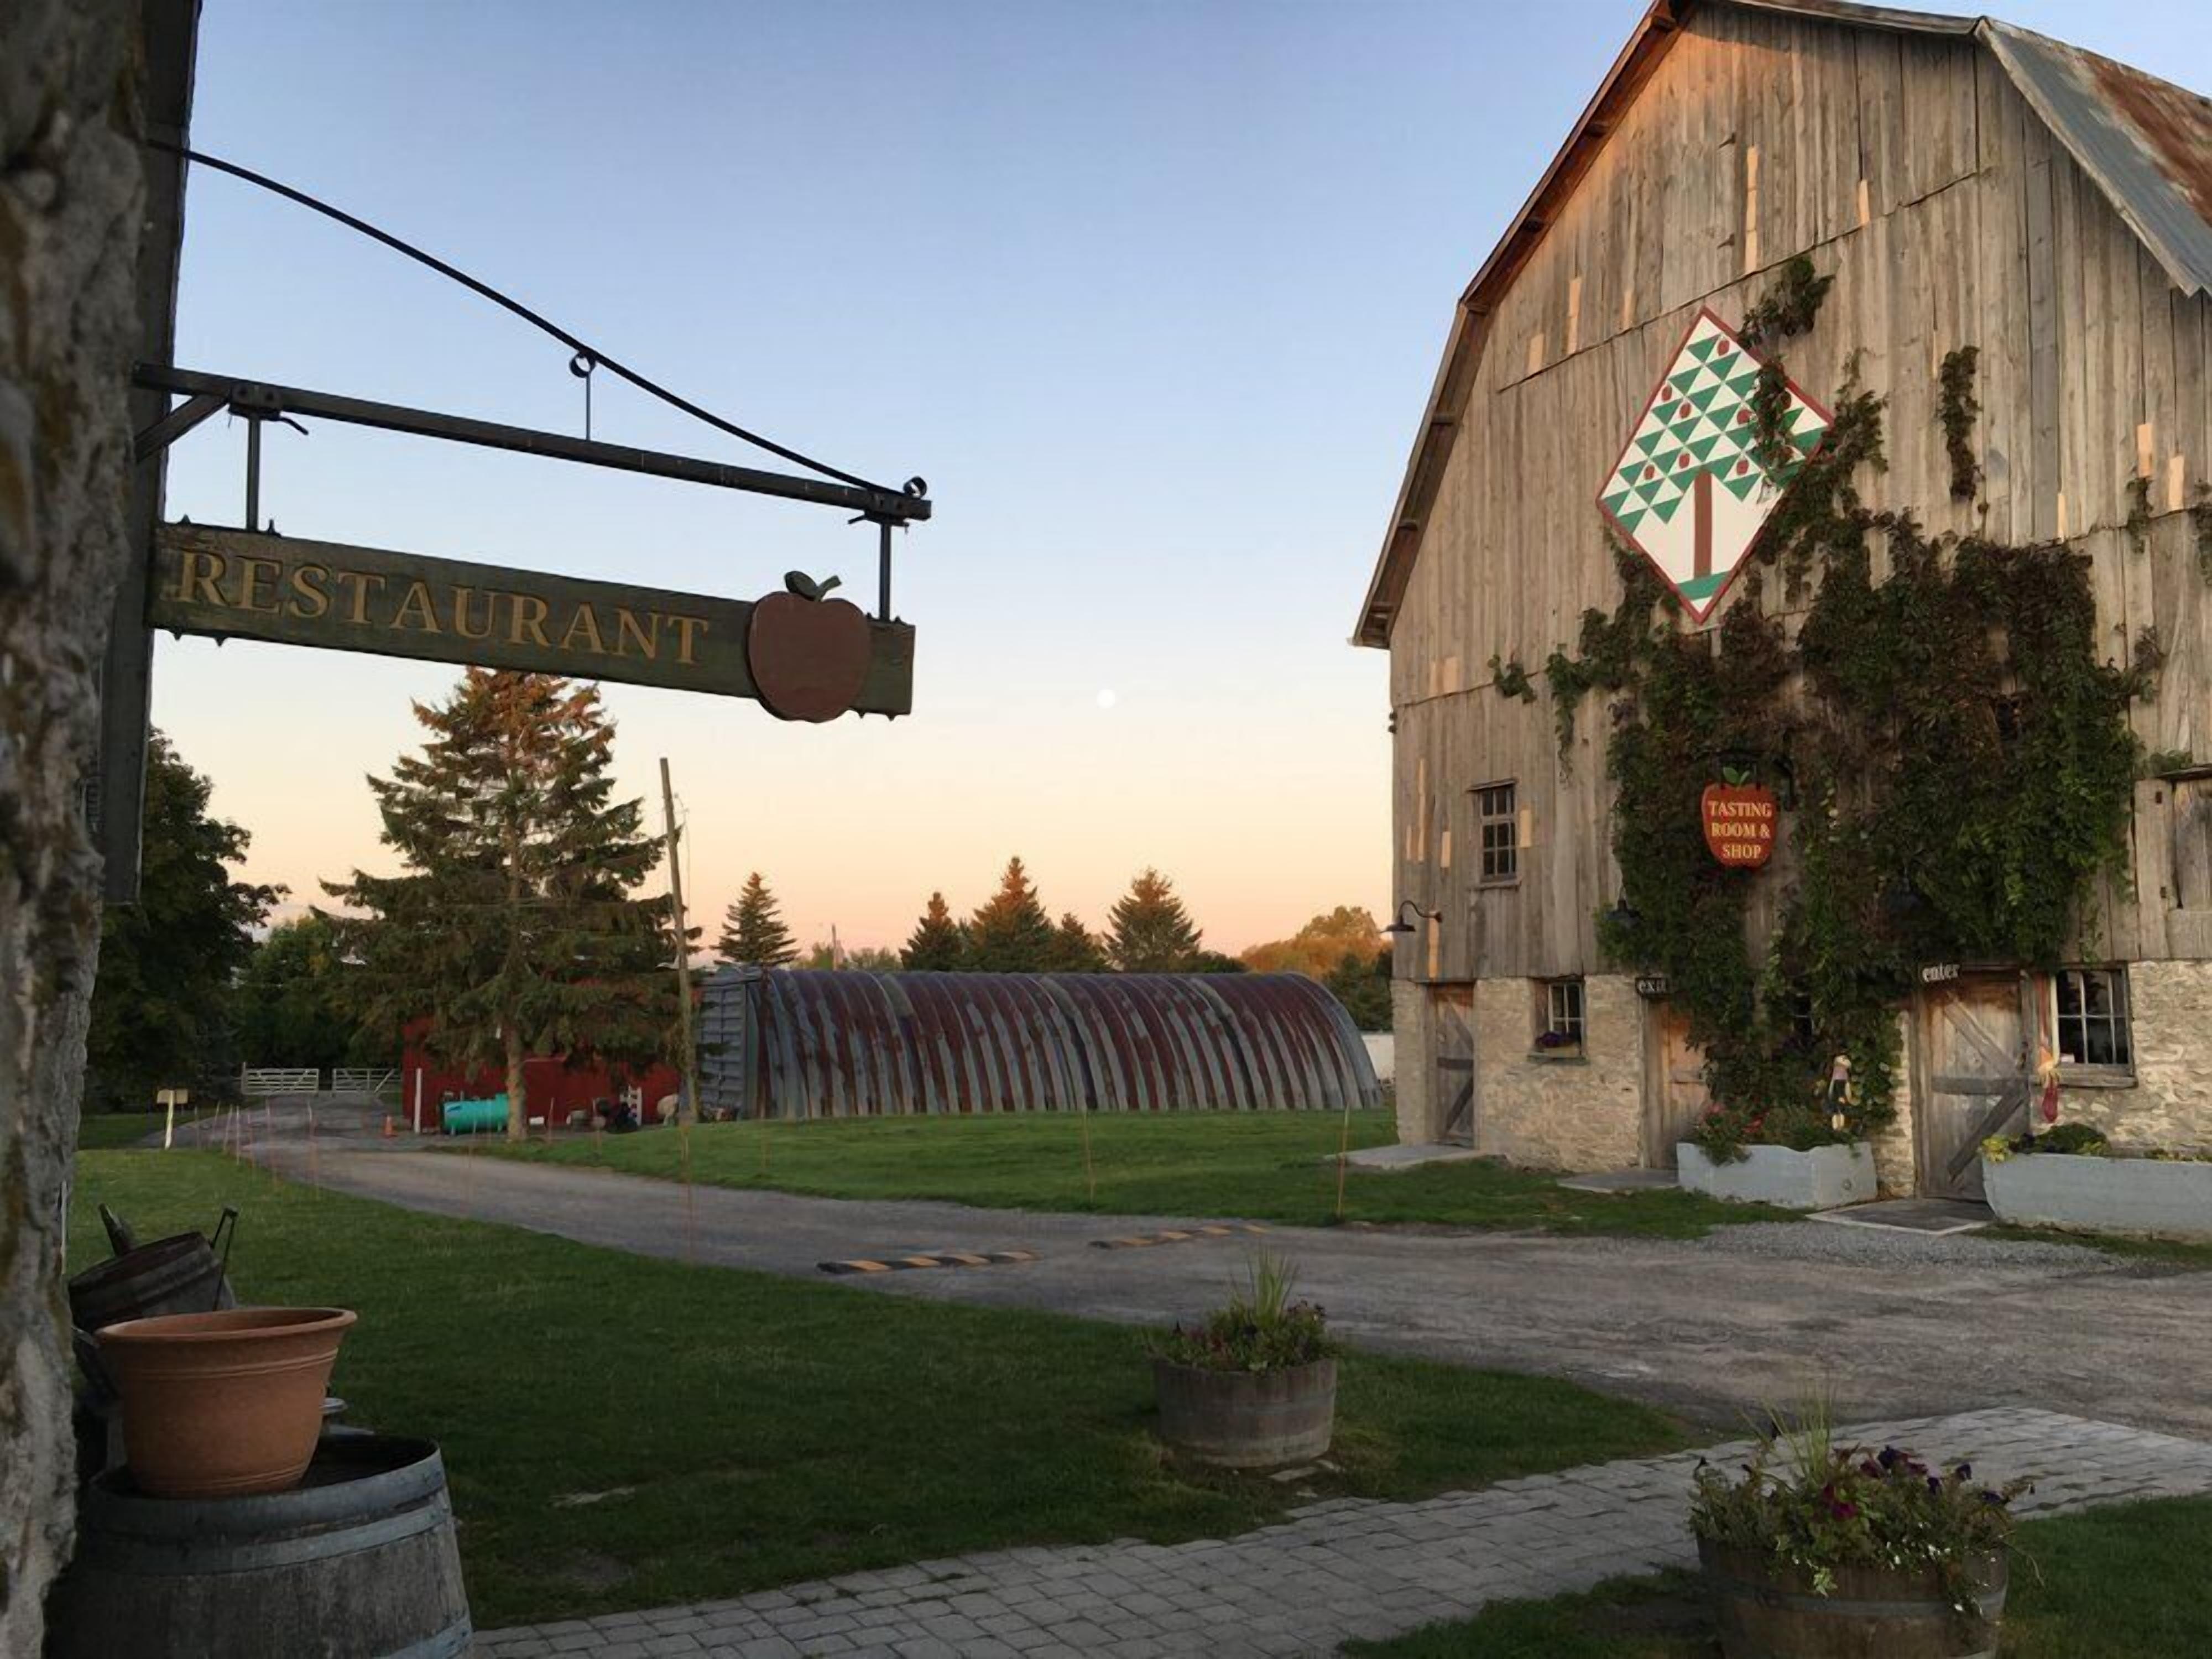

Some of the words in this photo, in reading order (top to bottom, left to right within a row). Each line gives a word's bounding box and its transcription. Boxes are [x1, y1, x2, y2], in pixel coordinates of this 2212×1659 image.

[174, 549, 710, 664] RESTAURANT
[1707, 800, 1772, 817] TASTING
[1711, 822, 1756, 838] ROOM
[1759, 822, 1771, 839] &
[1721, 843, 1761, 859] SHOP
[1922, 962, 1960, 983] enter
